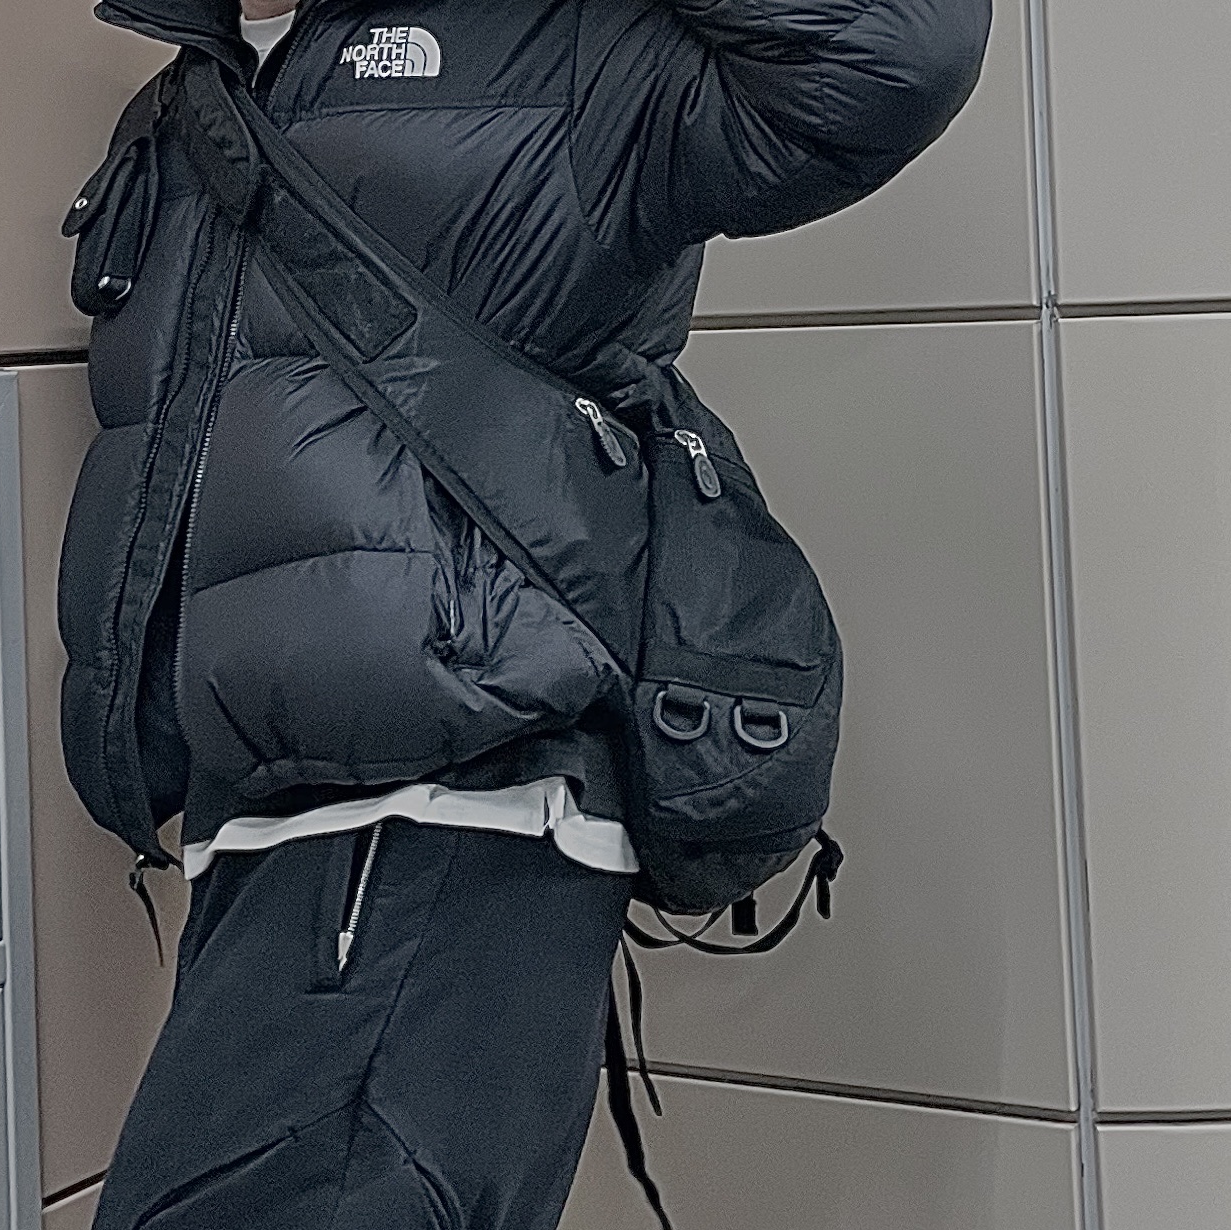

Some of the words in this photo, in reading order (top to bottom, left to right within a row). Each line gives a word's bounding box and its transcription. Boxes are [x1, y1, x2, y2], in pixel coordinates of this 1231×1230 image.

[370, 26, 409, 44] THE
[339, 43, 406, 64] NORTH
[355, 60, 404, 79] FACE
